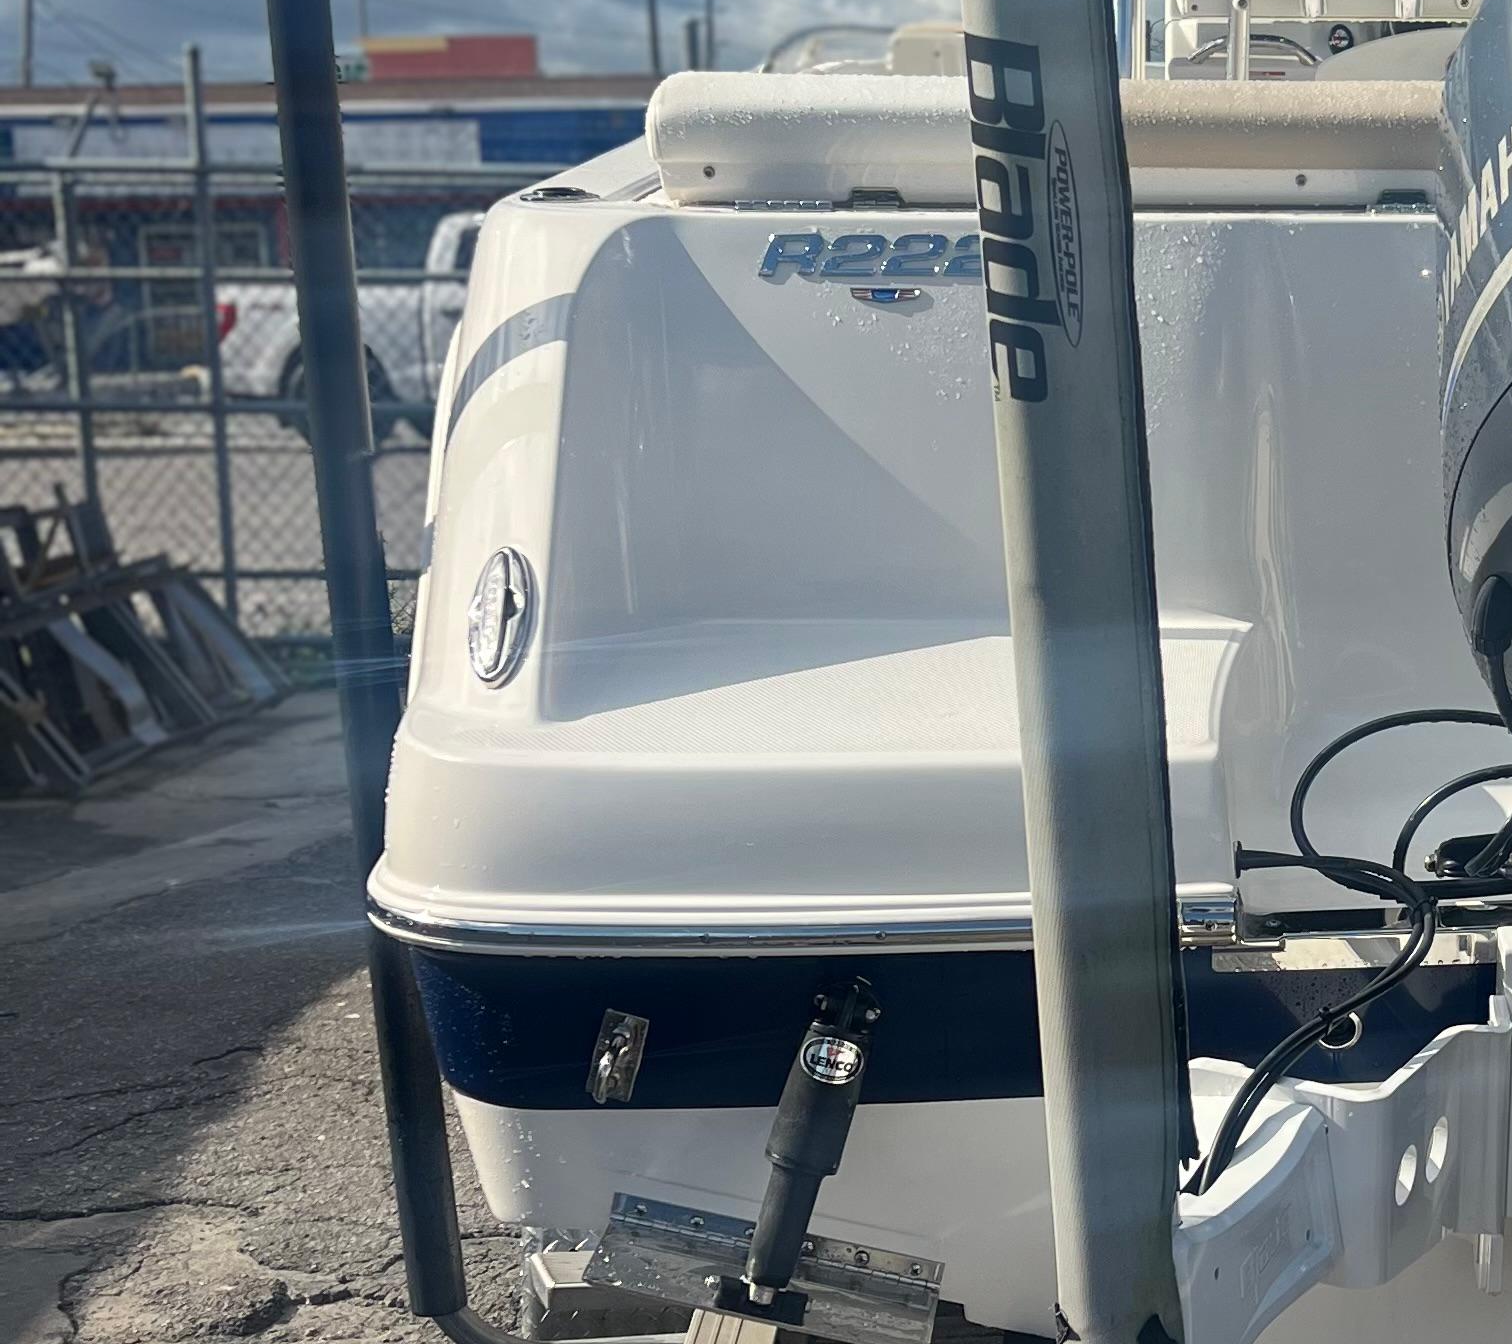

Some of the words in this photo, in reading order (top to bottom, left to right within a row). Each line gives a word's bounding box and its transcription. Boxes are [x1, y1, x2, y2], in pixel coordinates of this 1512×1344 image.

[964, 32, 1061, 403] Blade
[1054, 146, 1080, 323] POWER-POLE
[809, 1053, 853, 1072] LENCO
